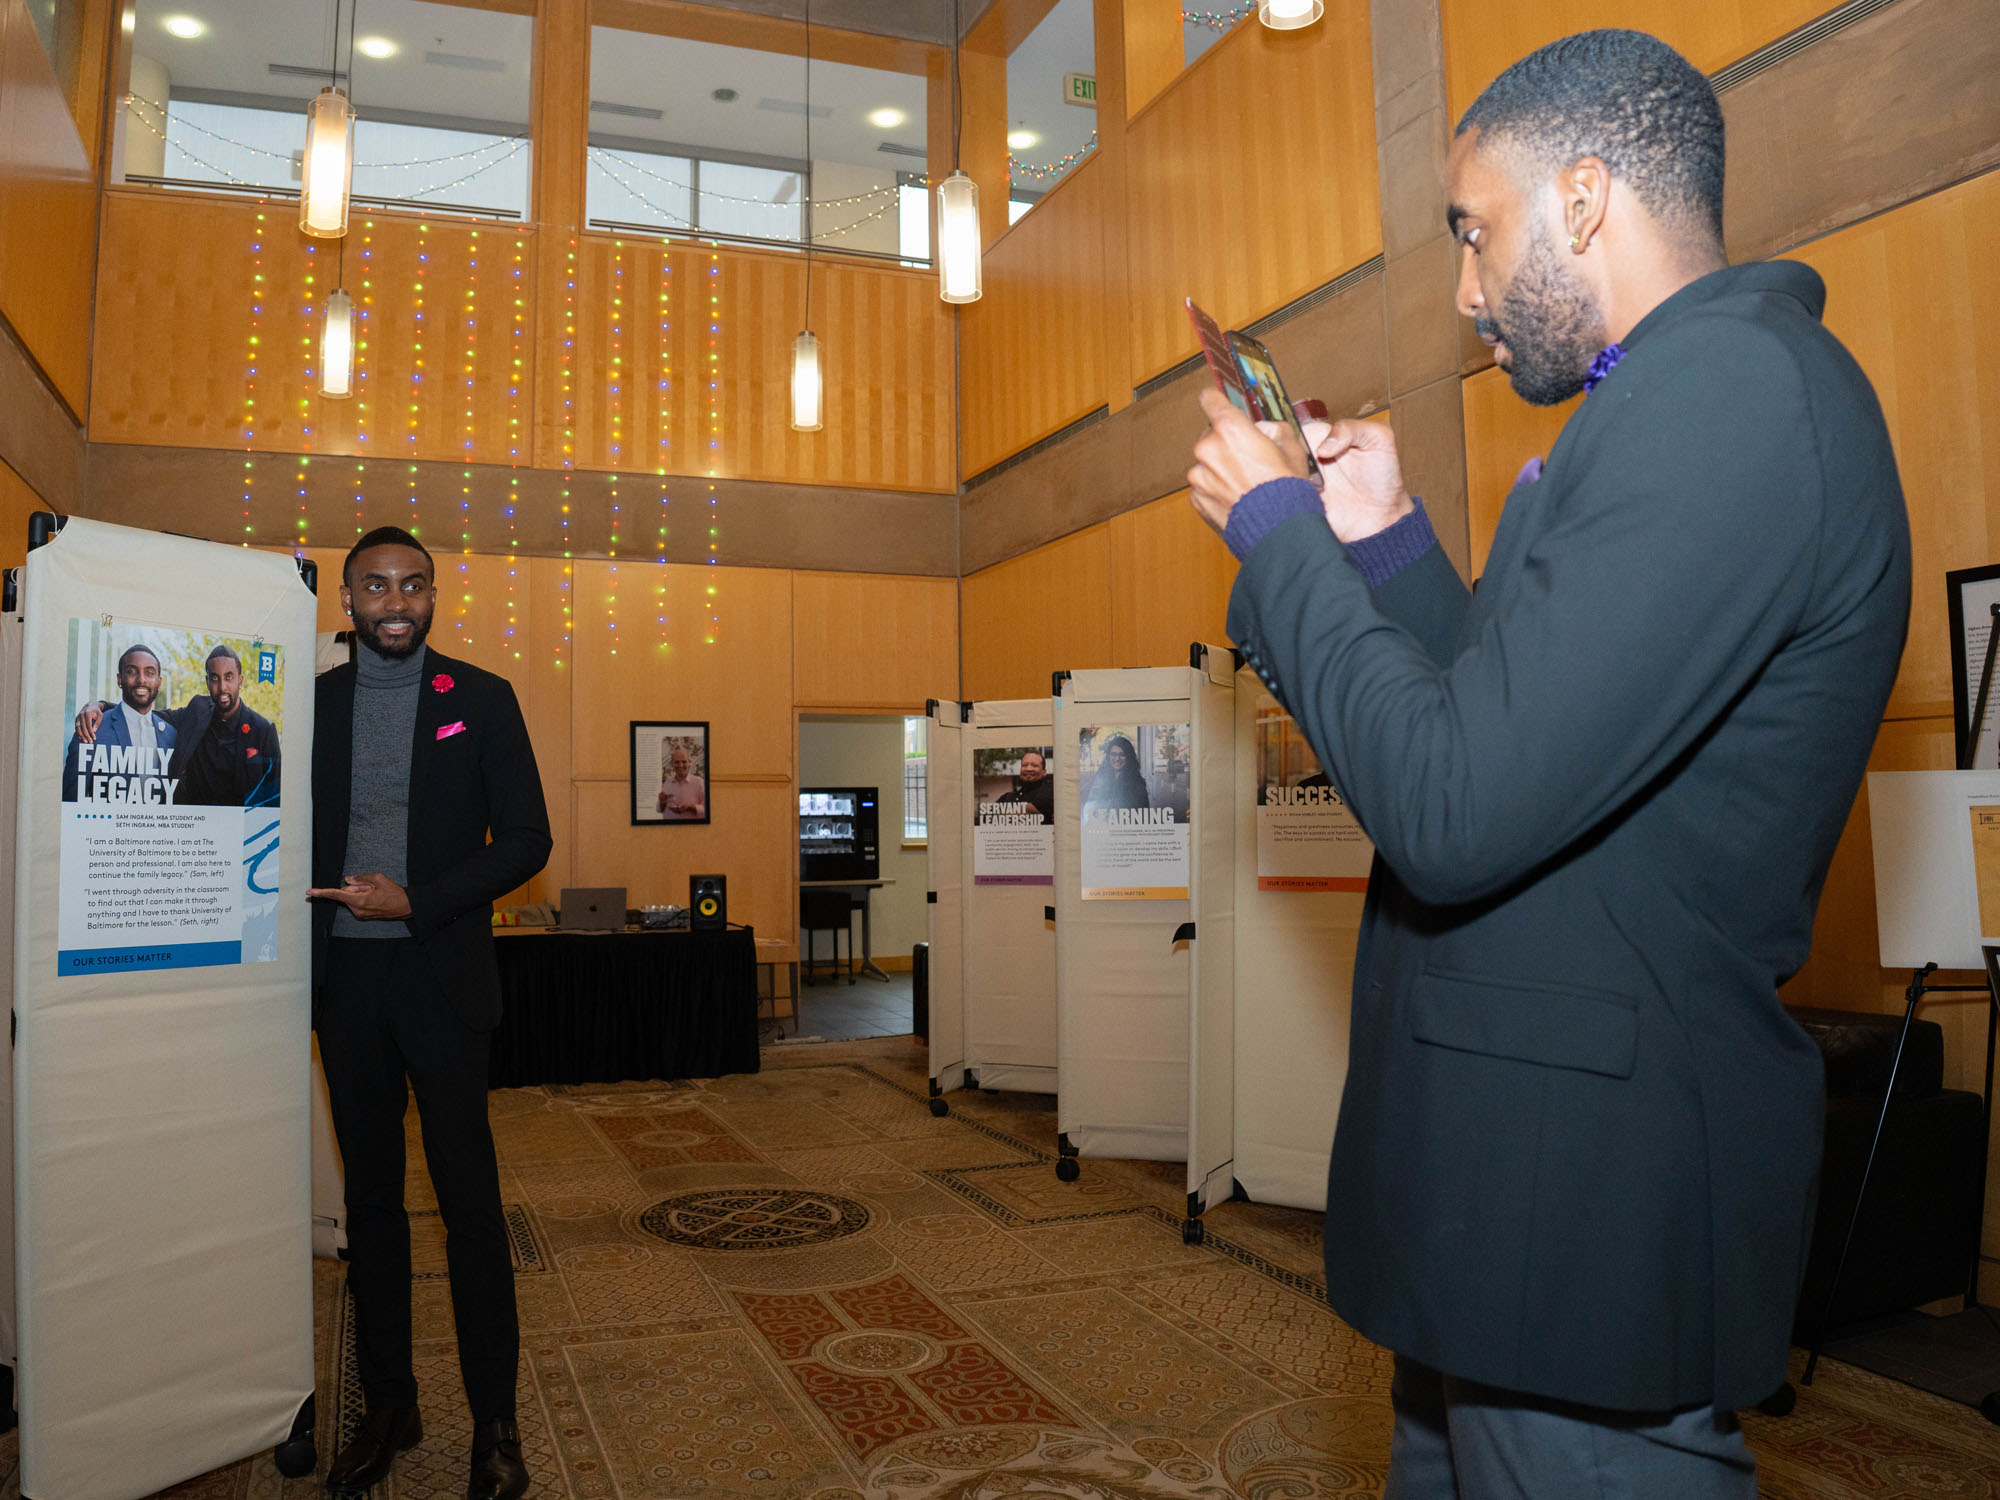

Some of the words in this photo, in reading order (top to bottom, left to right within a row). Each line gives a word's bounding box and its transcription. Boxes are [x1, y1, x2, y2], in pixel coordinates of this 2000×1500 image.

[262, 656, 272, 672] B
[78, 743, 175, 776] FAMILY
[77, 774, 180, 805] LEGACY
[1265, 786, 1346, 806] SUCCES
[979, 802, 1028, 814] SERVANT
[979, 814, 1044, 826] LEADERSHIP
[90, 849, 126, 858] University
[137, 871, 160, 879] family
[190, 870, 209, 878] (Sam,
[210, 870, 224, 878] left)
[112, 888, 141, 896] through
[143, 887, 174, 895] adversity
[192, 896, 218, 905] through
[88, 910, 121, 919] anything
[192, 906, 224, 915] University
[180, 918, 199, 927] (Seth,
[201, 917, 219, 926] right)
[73, 958, 94, 966] OUR
[97, 955, 134, 965] STORIES
[137, 952, 172, 962] MATTER
